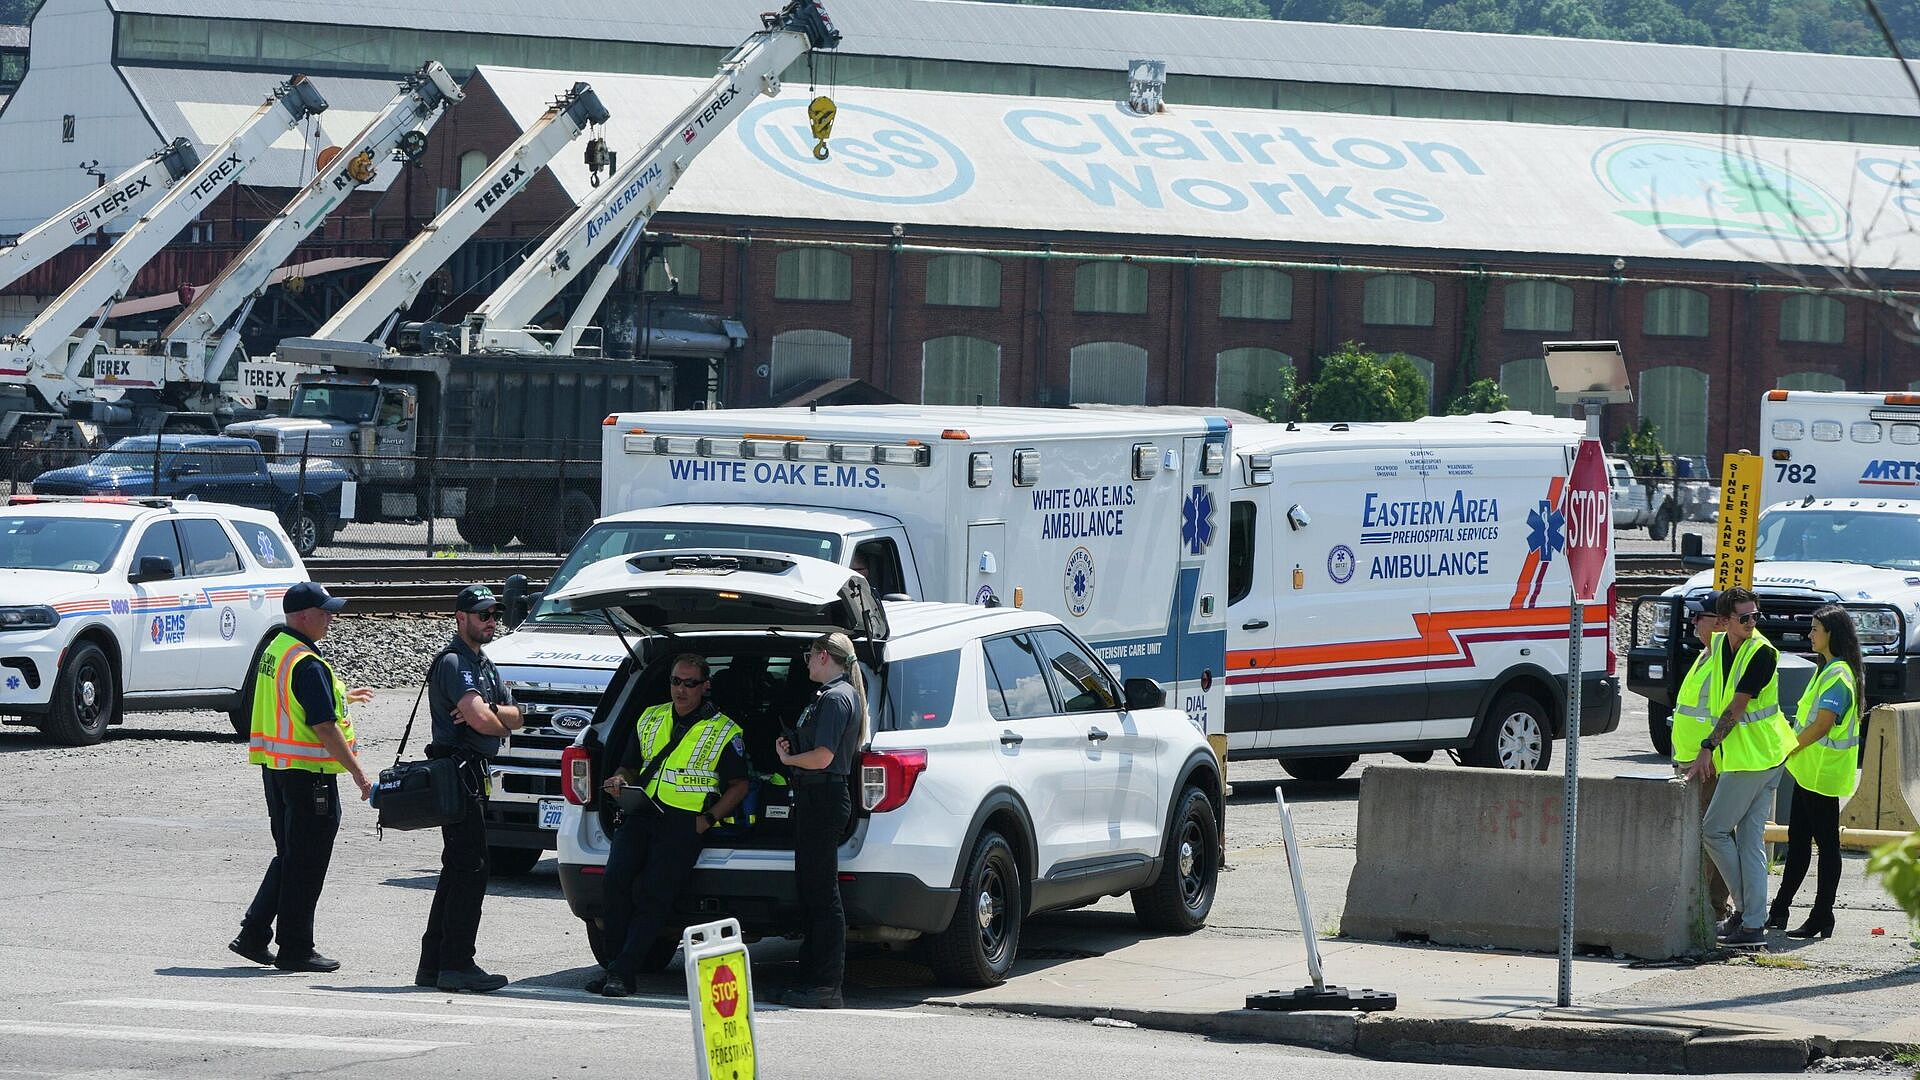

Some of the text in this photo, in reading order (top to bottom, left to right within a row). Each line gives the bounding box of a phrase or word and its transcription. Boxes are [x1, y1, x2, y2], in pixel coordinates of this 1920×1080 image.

[694, 84, 740, 129] TEREX
[762, 123, 940, 178] USS
[1003, 108, 1485, 177] Clairton
[190, 151, 242, 200] TEREX
[473, 161, 526, 214] TEREX
[624, 163, 663, 205] RENTAL
[89, 175, 152, 219] TEREX
[1040, 159, 1446, 224] Works
[97, 360, 130, 376] TEREX
[244, 368, 287, 388] TEREX
[331, 438, 345, 447] 262
[669, 459, 886, 488] WHITE OAK E.M.S.
[1774, 463, 1817, 484] 782
[1032, 485, 1136, 510] WHITE OAK E.M.S.
[1739, 484, 1750, 524] FIRST
[1042, 510, 1124, 539] AMBULANCE
[1569, 489, 1607, 549] STOP
[1719, 463, 1738, 591] SINGLE LANE PARKI
[1392, 526, 1499, 544] PREHOSPITAL SERVICES
[1735, 529, 1746, 553] ROW
[1370, 551, 1489, 579] AMBULANCE
[165, 614, 186, 632] EMS
[165, 632, 185, 643] WEST
[1128, 644, 1146, 656] CARE
[1147, 642, 1162, 654] UNIT
[1186, 695, 1208, 713] DIAL
[561, 716, 583, 728] Ford
[682, 776, 711, 785] CHIEF
[543, 811, 562, 824] EM
[712, 981, 736, 1003] STOP
[724, 1020, 737, 1039] FOR
